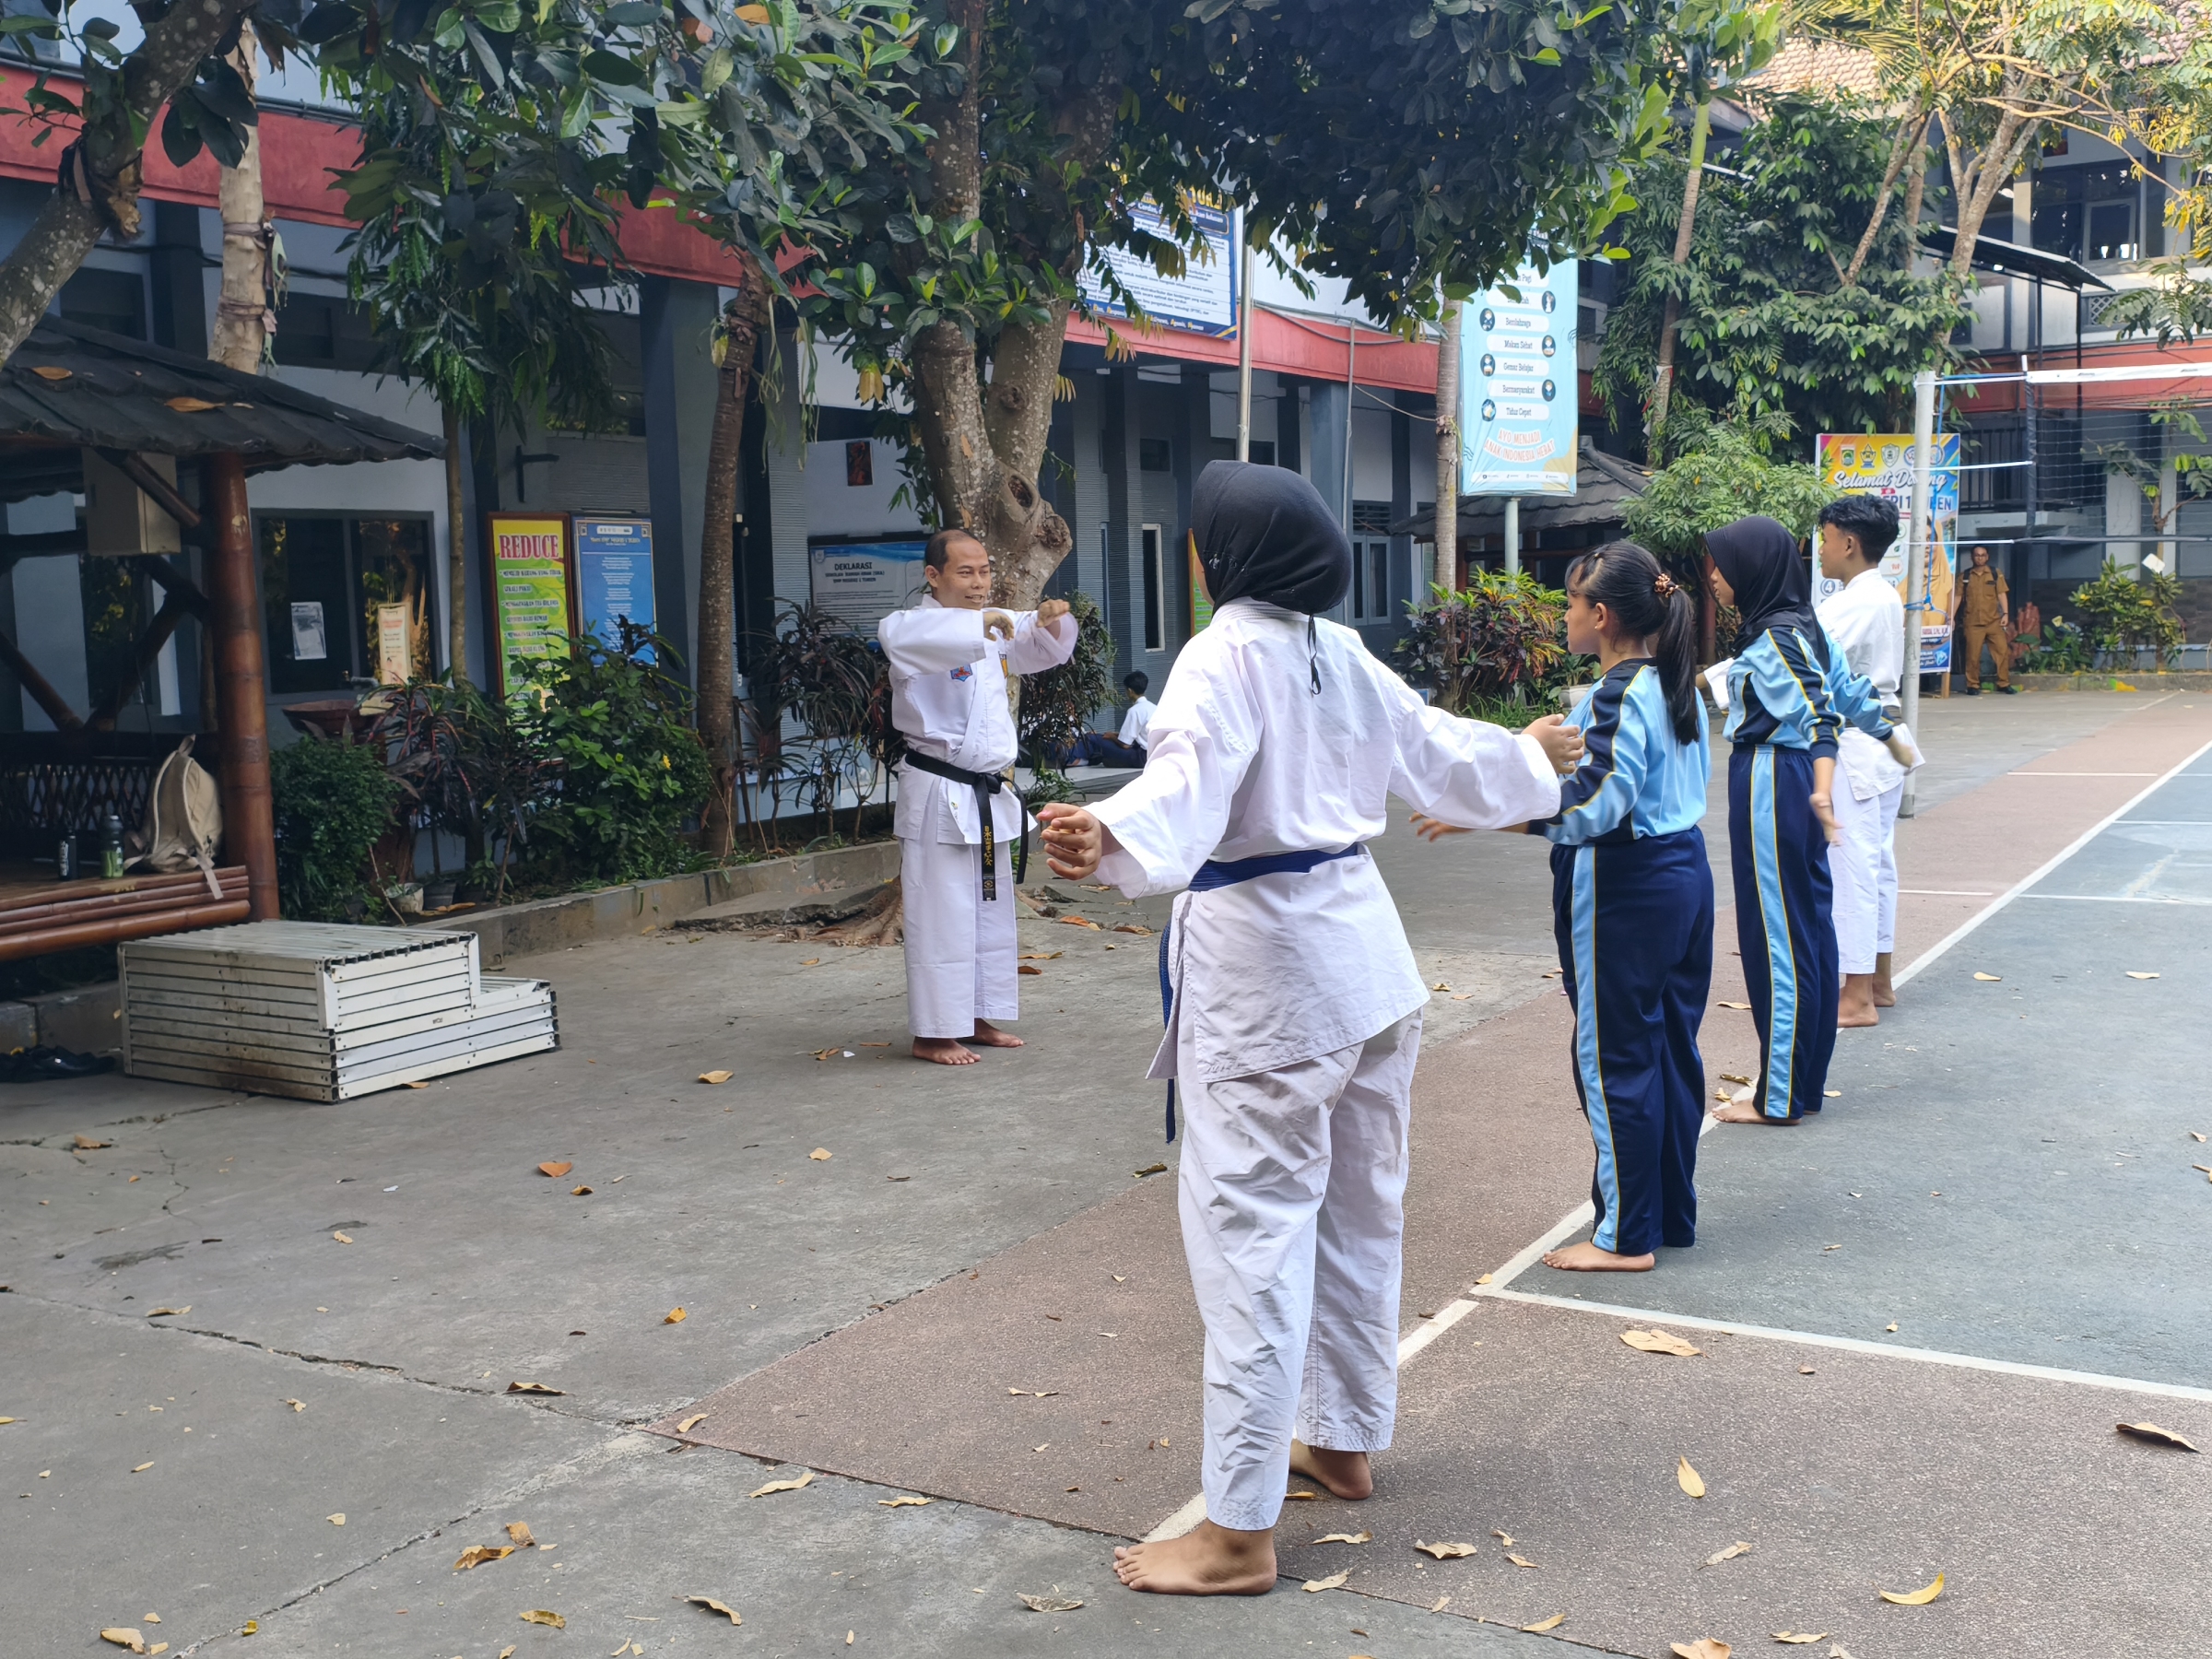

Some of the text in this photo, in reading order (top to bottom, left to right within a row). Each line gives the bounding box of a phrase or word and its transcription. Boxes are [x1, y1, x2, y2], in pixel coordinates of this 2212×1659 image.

[1504, 340, 1533, 349] Makan Sehat
[1519, 363, 1534, 373] Belajar
[1519, 408, 1532, 418] Cepat
[1498, 429, 1541, 444] AYO MENJADI
[1484, 439, 1555, 462] ANAK INDONESIA HEBAT
[1833, 468, 1947, 493] Selamat Dang
[500, 535, 559, 559] REDUCE
[834, 561, 872, 571] DEKLARASI
